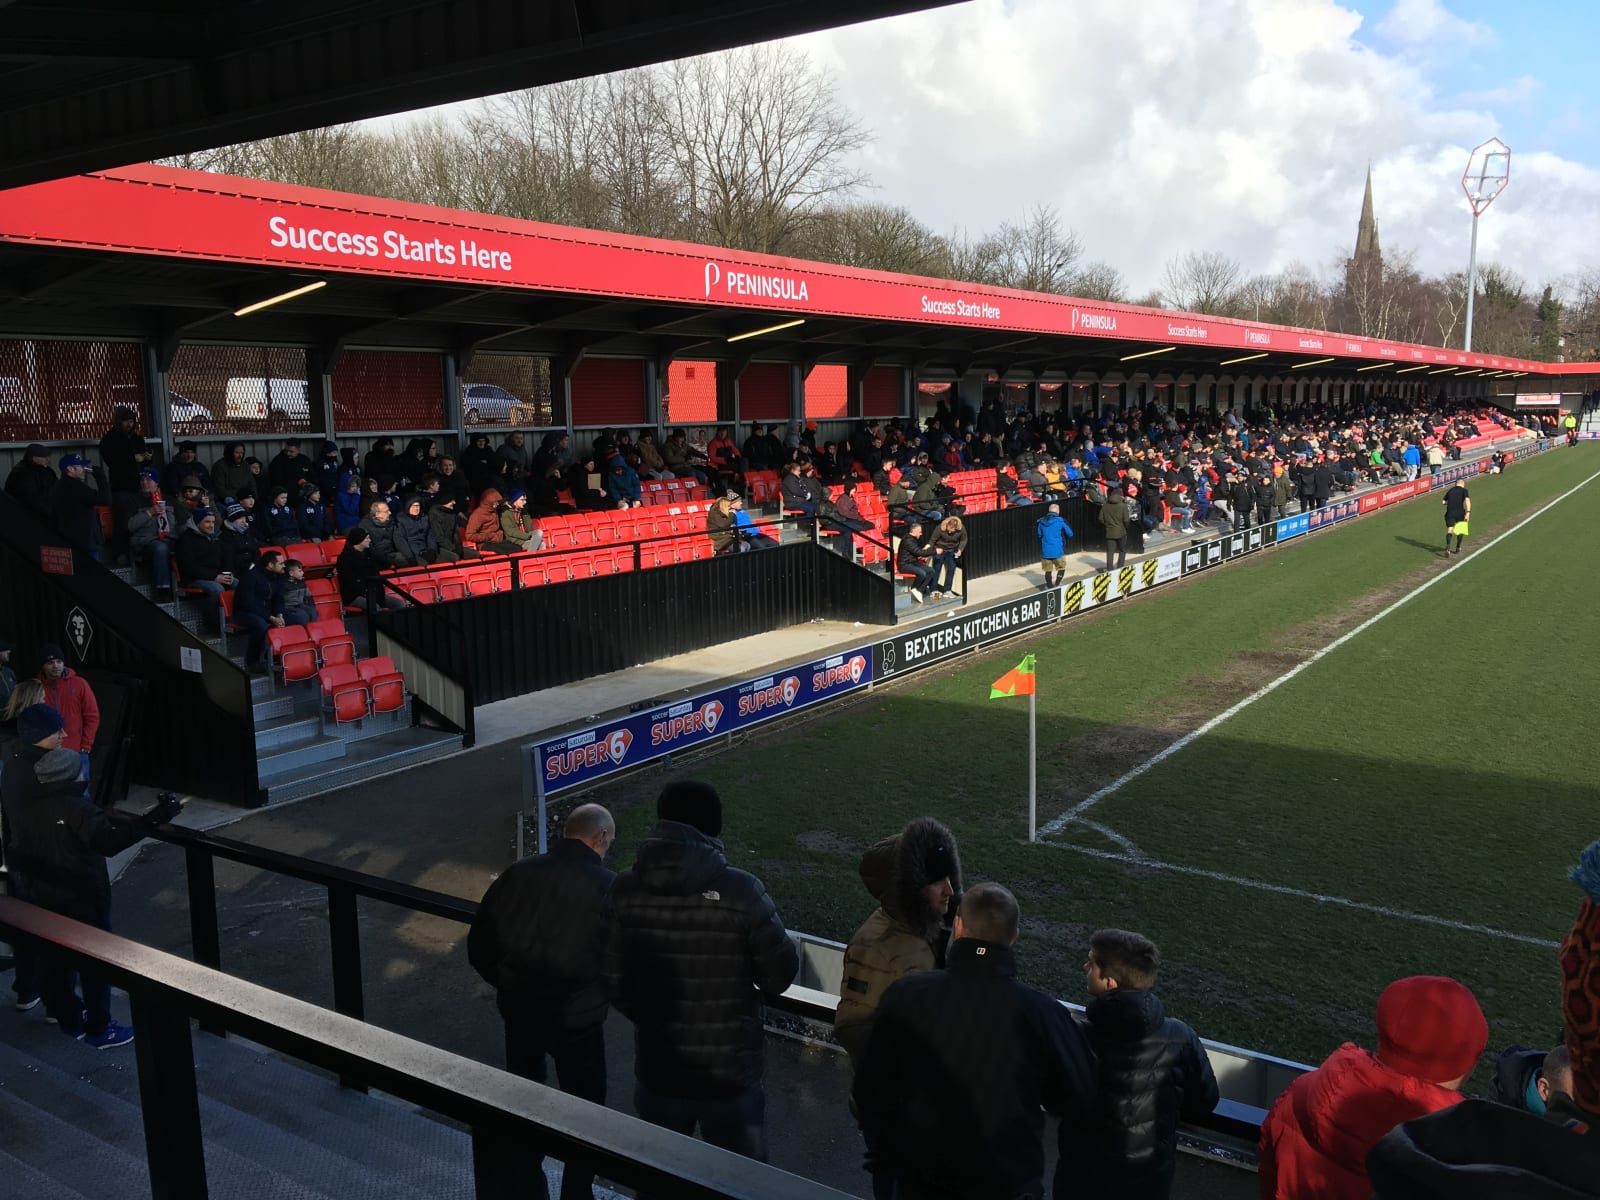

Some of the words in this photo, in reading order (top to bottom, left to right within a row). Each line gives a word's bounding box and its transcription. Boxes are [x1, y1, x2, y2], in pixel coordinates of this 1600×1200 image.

[269, 216, 379, 257] Success
[383, 230, 456, 265] Starts
[460, 239, 512, 271] Here
[727, 271, 809, 301] PENINSULA
[921, 295, 956, 316] Success
[956, 298, 981, 318] Starts
[981, 302, 1001, 320] Here
[1081, 313, 1117, 331] PENINSULA
[905, 626, 961, 661] BEXTERS
[963, 610, 1009, 641] KITCHEN
[1011, 606, 1019, 624] &
[1020, 600, 1041, 622] BAR
[813, 664, 850, 692] SUPER
[739, 686, 782, 716] SUPER
[651, 711, 703, 746] SUPER
[546, 742, 567, 753] soccer
[546, 741, 608, 780] SUPER
